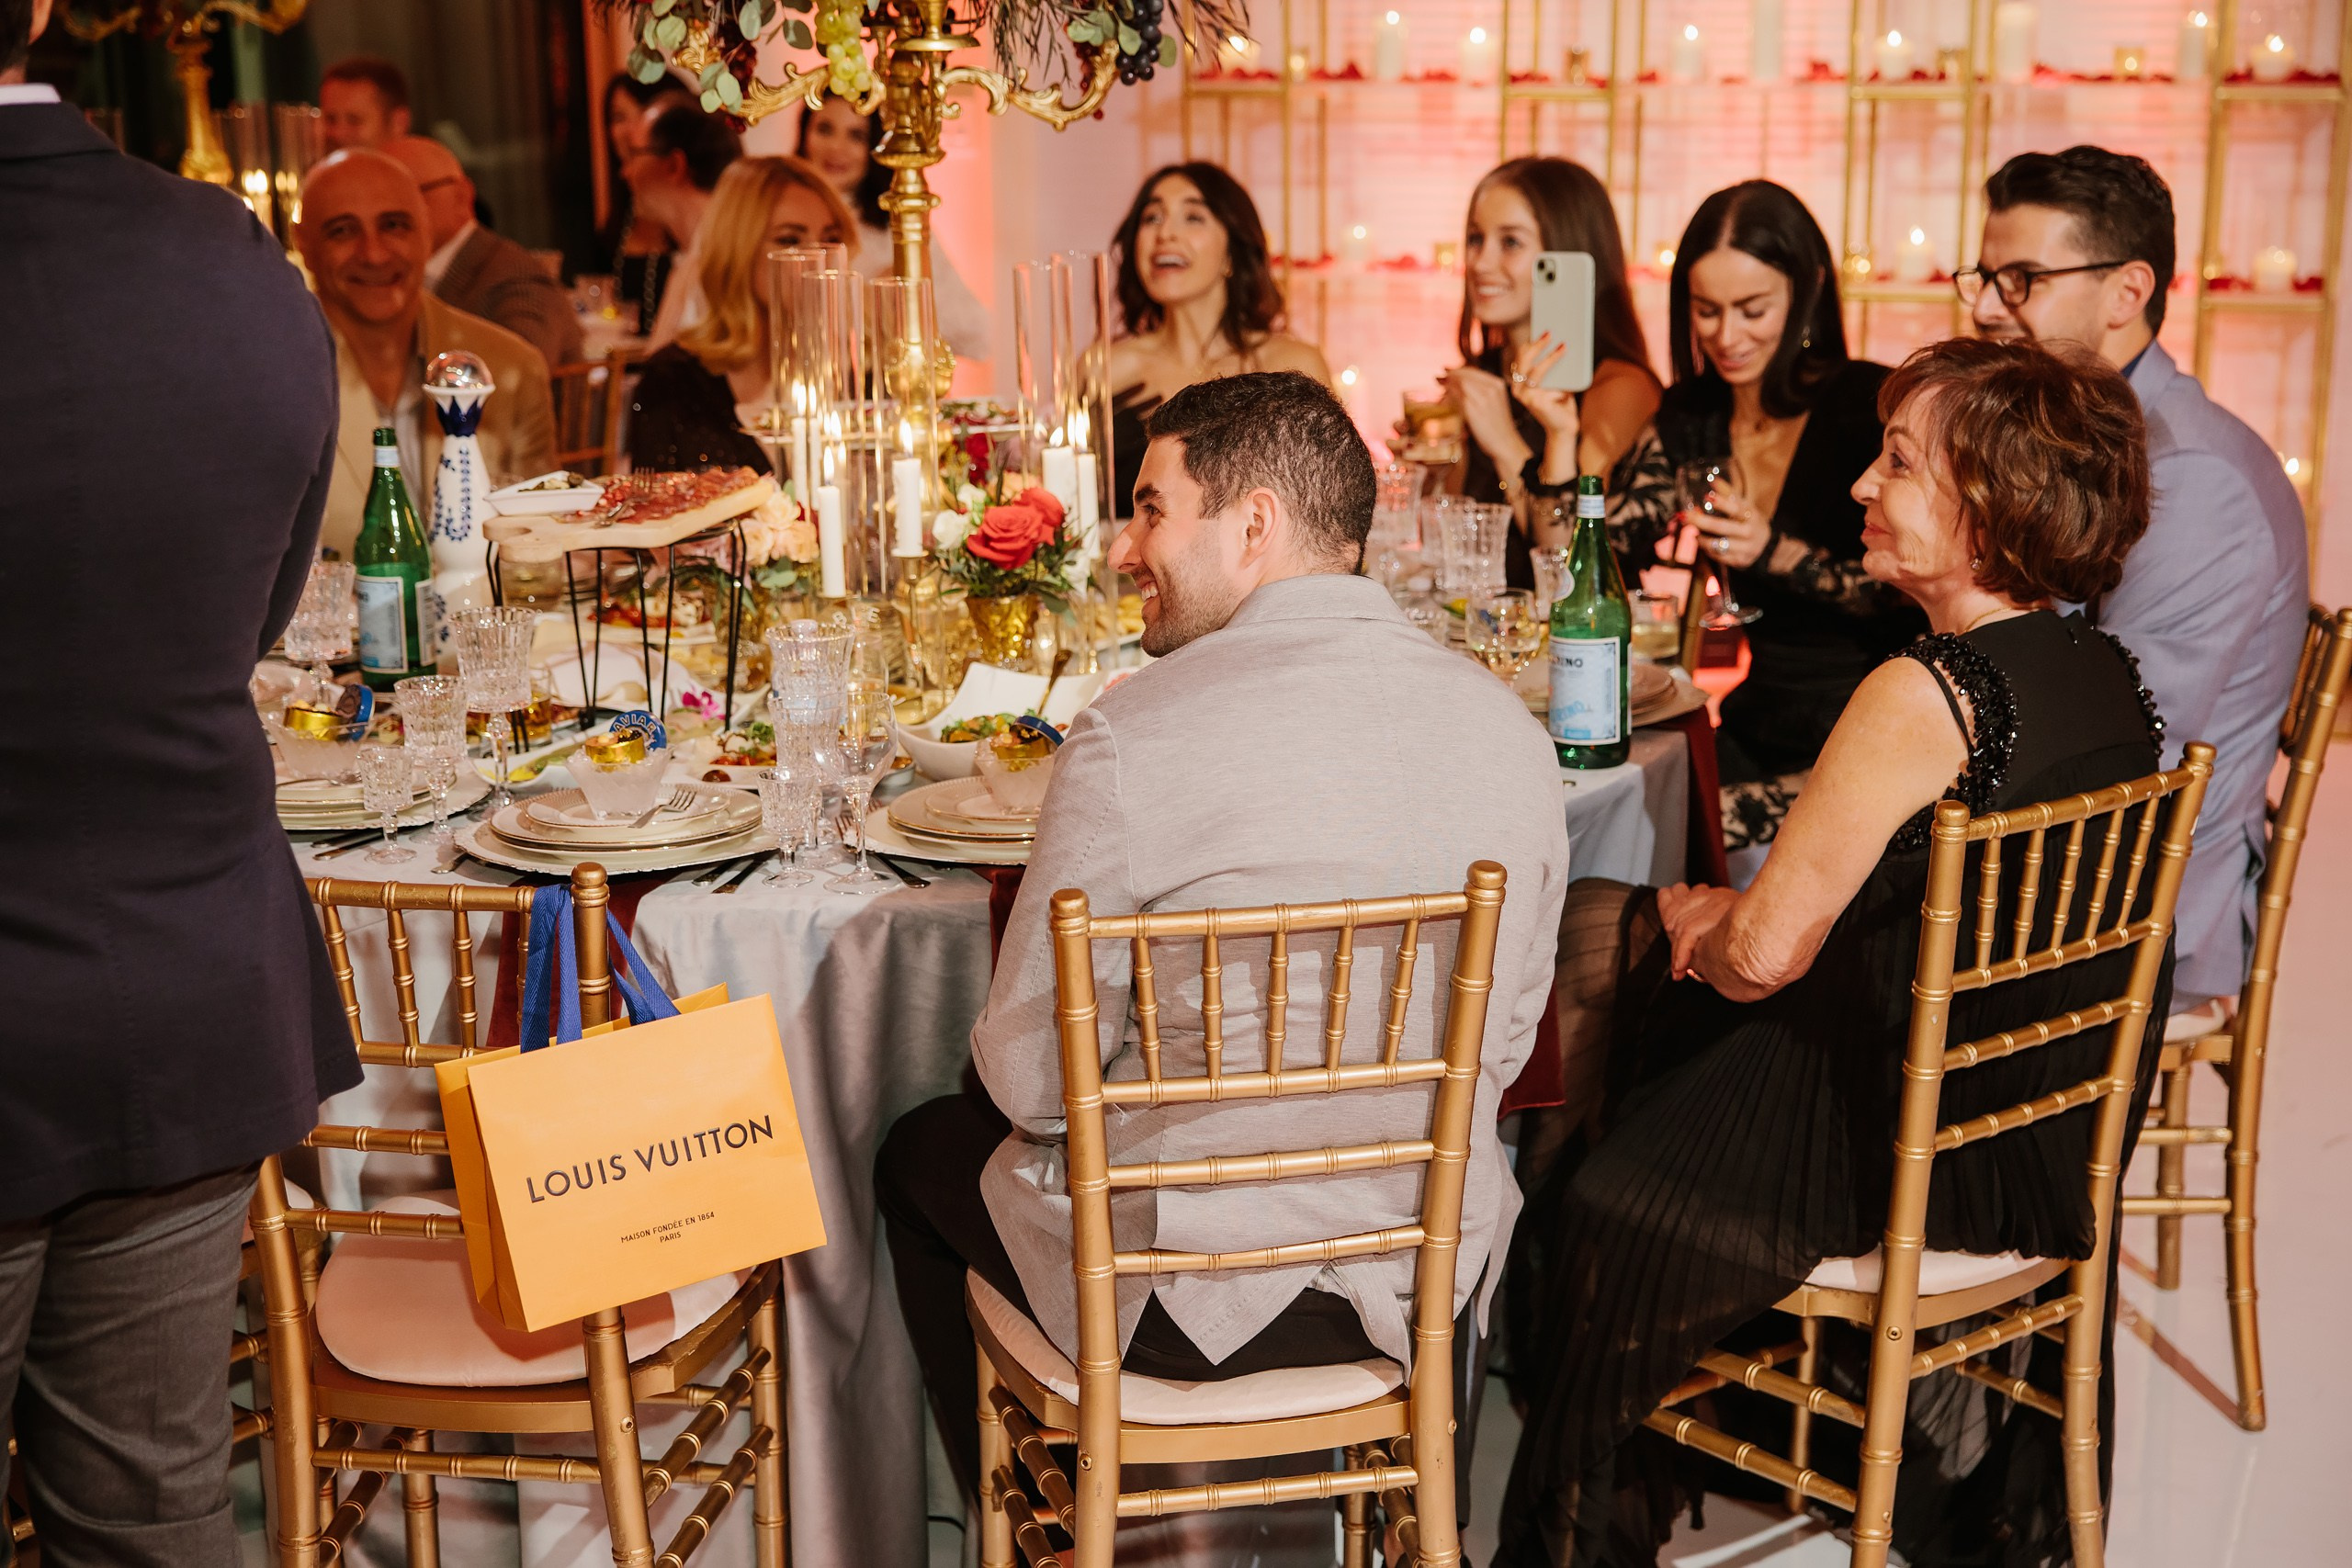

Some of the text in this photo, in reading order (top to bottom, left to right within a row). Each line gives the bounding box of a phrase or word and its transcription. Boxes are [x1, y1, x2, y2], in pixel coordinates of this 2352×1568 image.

[613, 714, 657, 735] AVIAR
[526, 1114, 774, 1204] LOUIS VUITTON
[620, 1211, 715, 1244] MAISON FONDÉE EN 1854
[659, 1231, 682, 1243] PARIS
